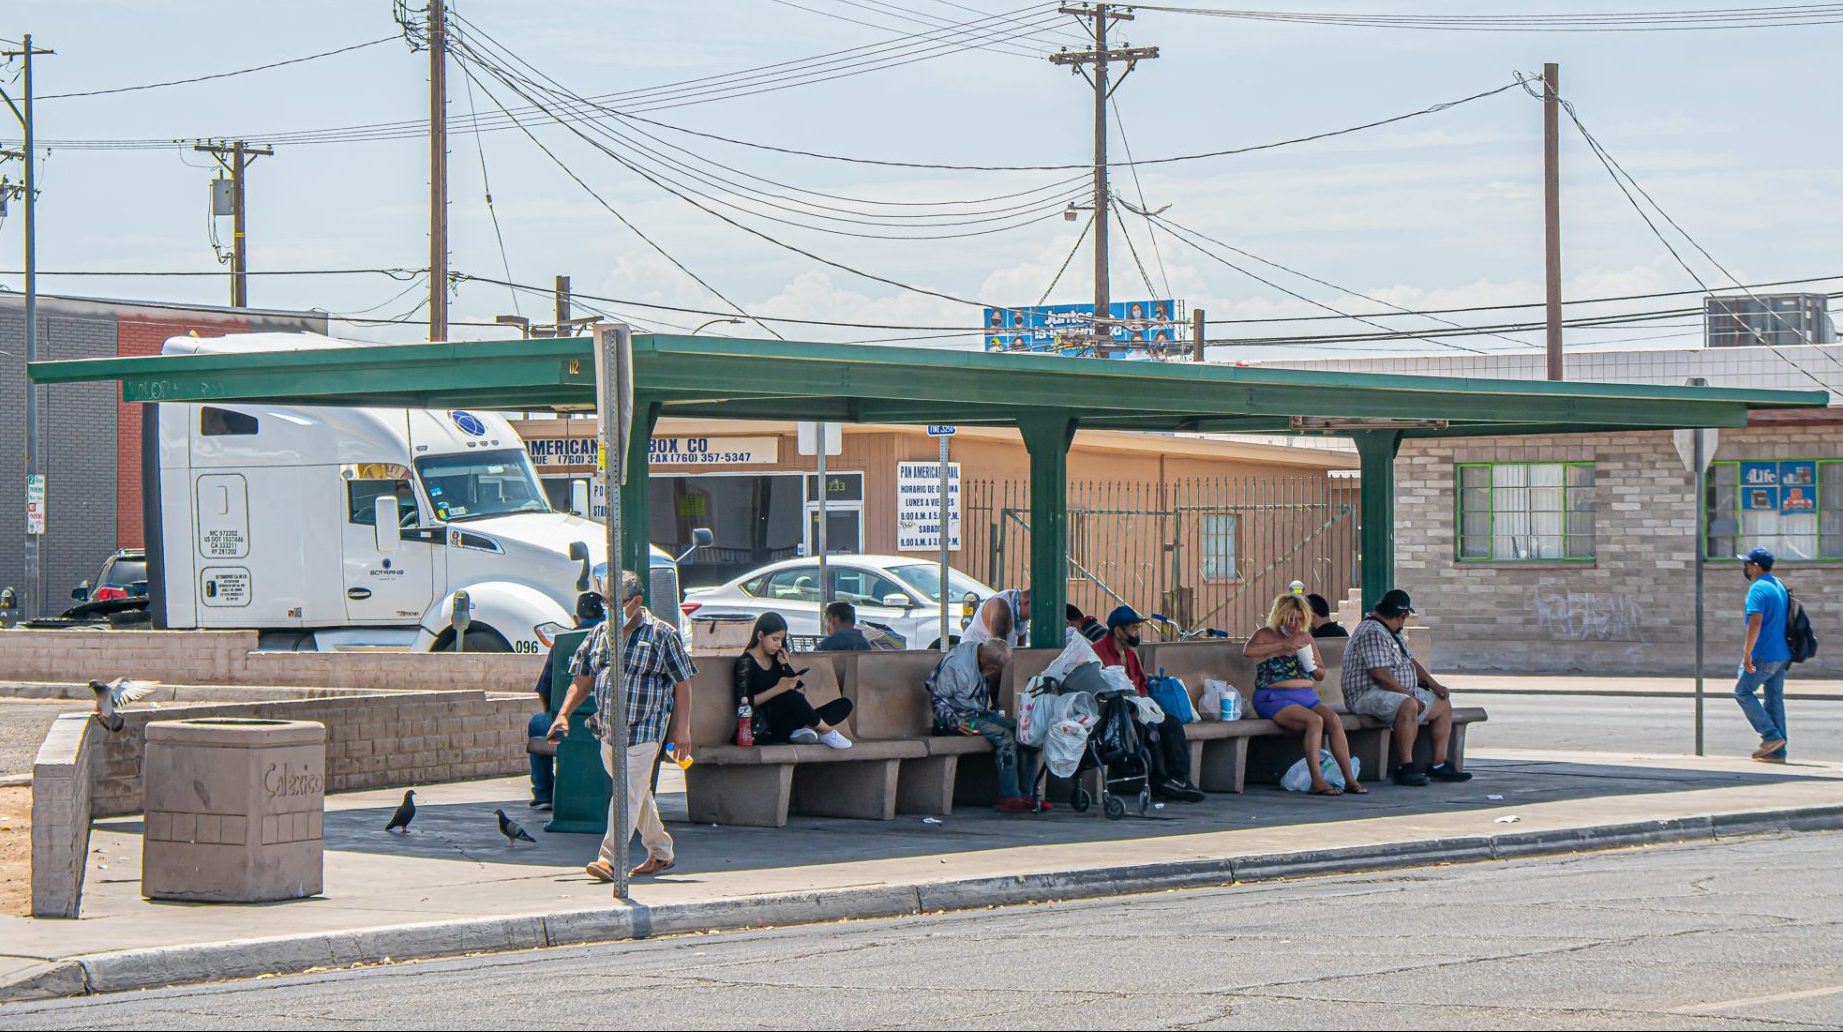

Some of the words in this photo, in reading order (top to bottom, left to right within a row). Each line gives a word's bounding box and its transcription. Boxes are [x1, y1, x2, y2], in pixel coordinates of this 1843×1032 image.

[648, 438, 678, 454] BOX
[687, 438, 708, 453] CO
[558, 454, 585, 465] (760)
[649, 453, 668, 463] FAX
[671, 453, 698, 463] (760)
[701, 452, 752, 463] 357-5347
[900, 466, 912, 479] PAN
[913, 466, 941, 479] AMERICA
[900, 485, 927, 494] HORARIO
[927, 485, 935, 493] DE
[905, 498, 924, 507] LUNES
[925, 498, 930, 506] A
[593, 505, 606, 517] STA
[515, 640, 539, 654] 096
[265, 762, 324, 798] Calexico
